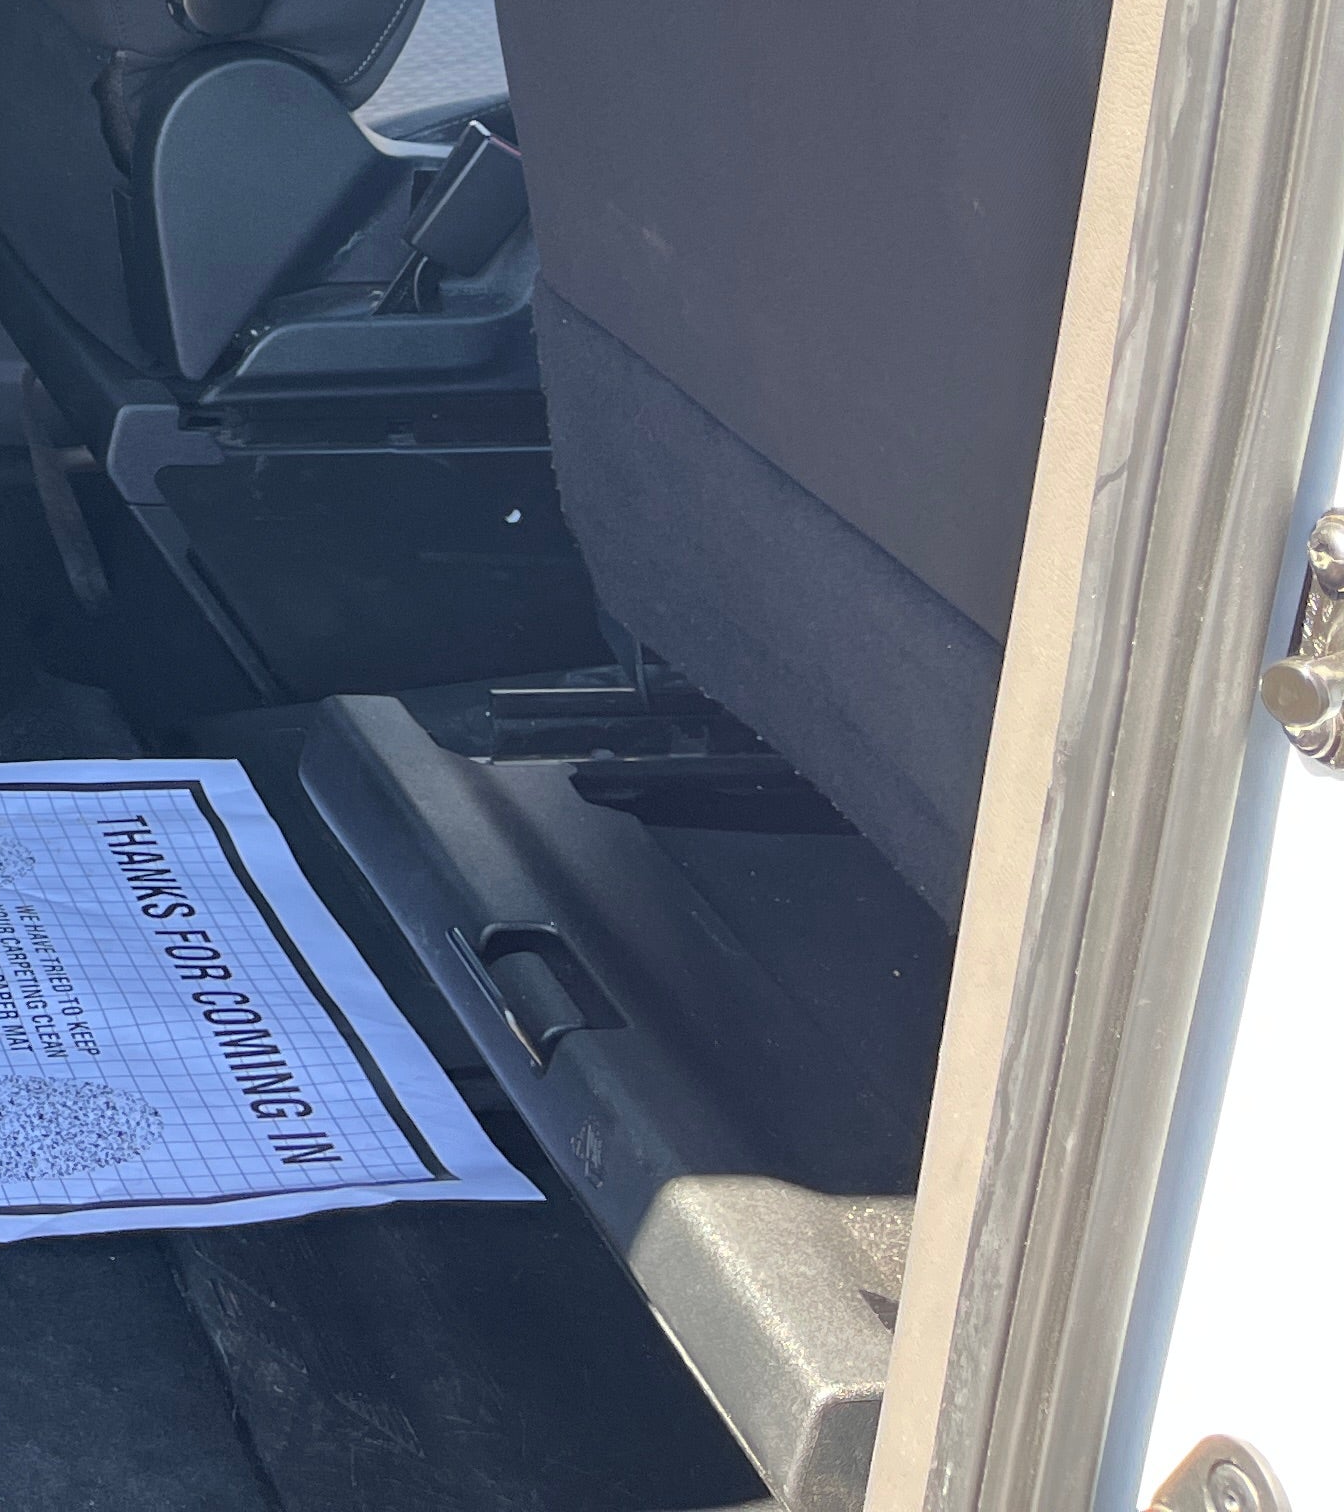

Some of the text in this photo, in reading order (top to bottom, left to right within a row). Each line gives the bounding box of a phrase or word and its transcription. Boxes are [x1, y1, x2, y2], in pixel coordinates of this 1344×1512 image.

[0, 938, 47, 1010] CARPETING
[32, 1014, 69, 1058] CLEAN
[2, 1025, 33, 1052] MAT
[15, 905, 101, 1056] WE HAVE TRIED TO KEEP
[97, 815, 343, 1165] THANKS FOR COMING IN
